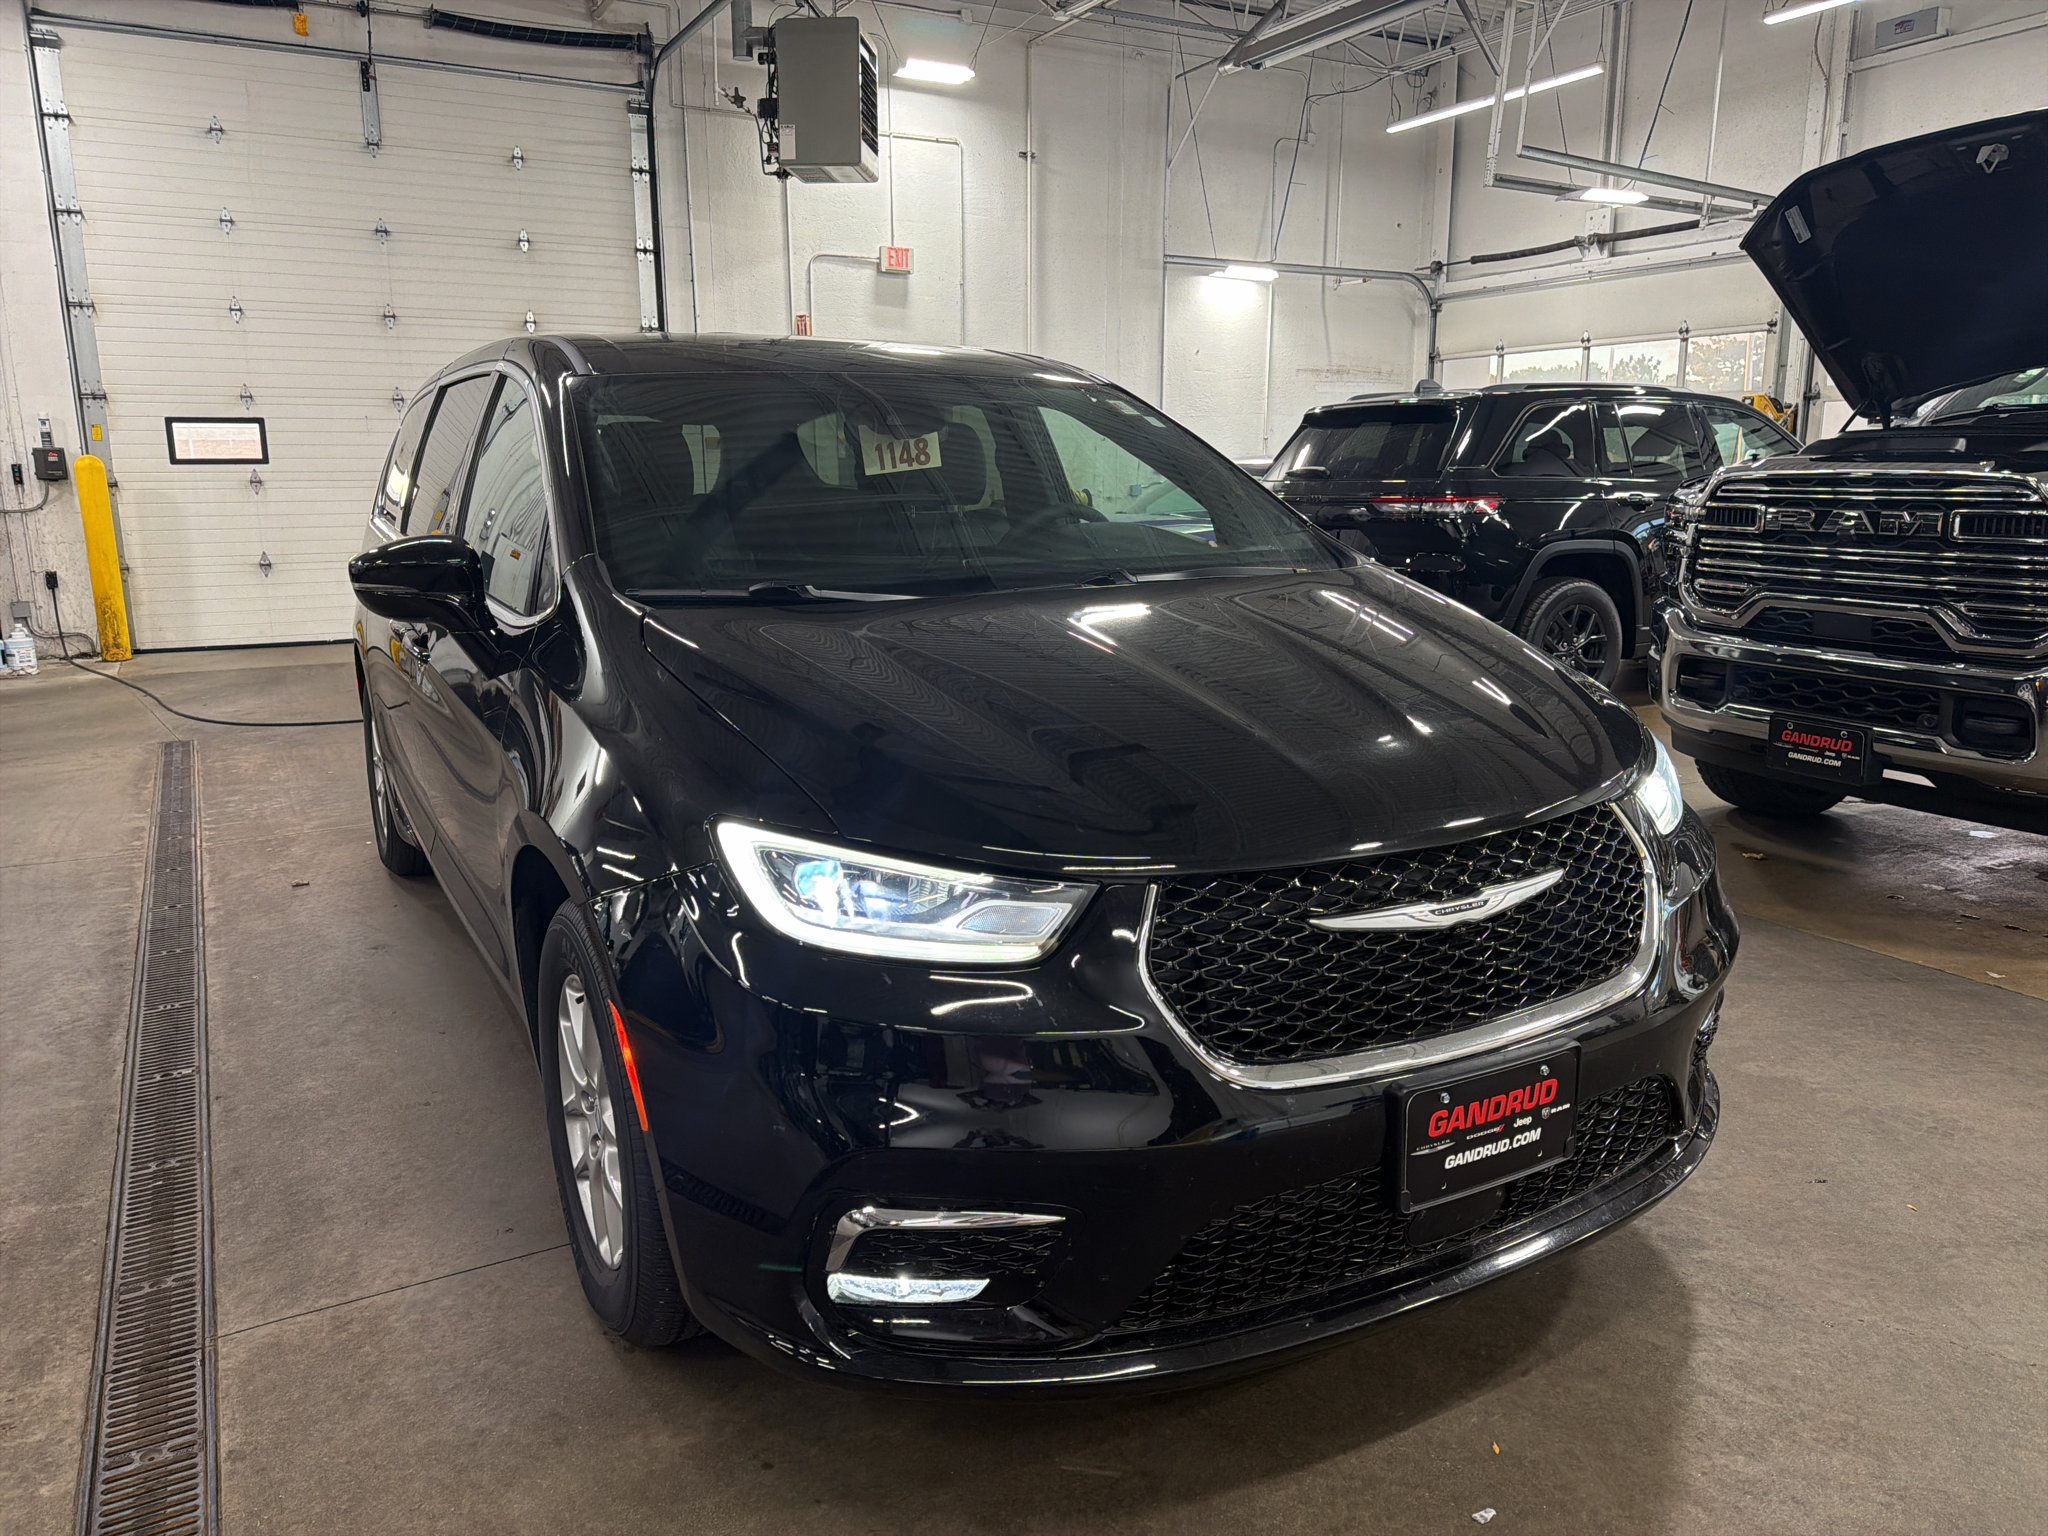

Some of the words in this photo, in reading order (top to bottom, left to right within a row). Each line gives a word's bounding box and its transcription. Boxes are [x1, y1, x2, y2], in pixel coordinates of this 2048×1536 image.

[887, 247, 909, 269] EXIT
[875, 437, 931, 471] 1148
[1765, 508, 1943, 535] RAM
[1781, 730, 1853, 752] GANDRUD
[1788, 751, 1842, 767] GANDRUD.COM
[1434, 901, 1485, 915] CHRYSLER
[1428, 1078, 1558, 1137] GANDRUD
[1466, 1126, 1499, 1140] DODGE
[1513, 1116, 1532, 1128] Jeep
[1551, 1103, 1570, 1114] RAM
[1444, 1127, 1541, 1169] GANDRUD.COM
